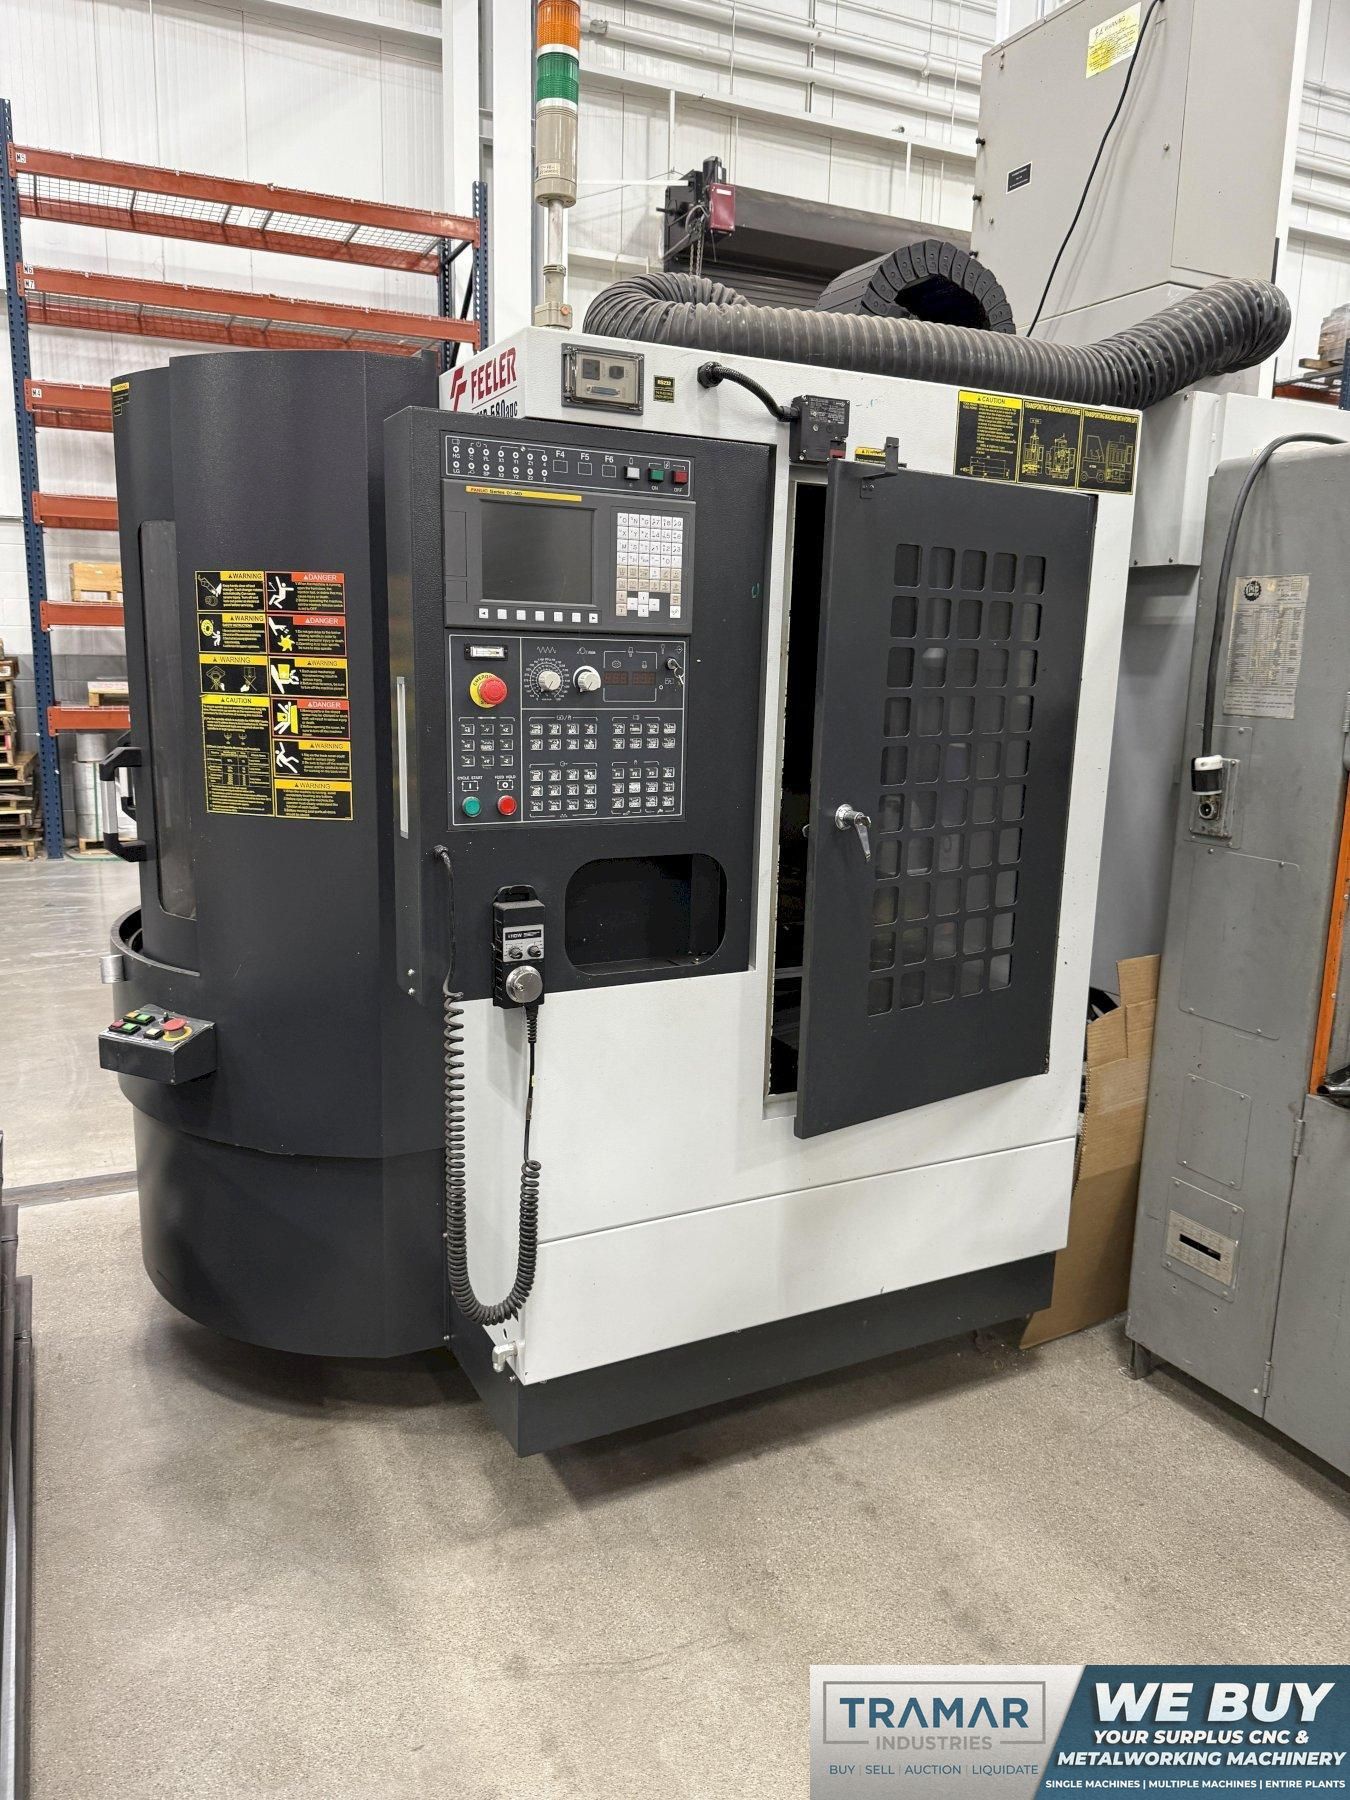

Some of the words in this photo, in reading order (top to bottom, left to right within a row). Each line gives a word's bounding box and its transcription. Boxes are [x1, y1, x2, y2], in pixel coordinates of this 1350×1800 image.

[471, 347, 516, 404] FEELER
[982, 396, 1006, 404] CAUTION
[605, 455, 614, 463] F6
[232, 571, 262, 579] WARNING
[220, 656, 251, 664] WARNING
